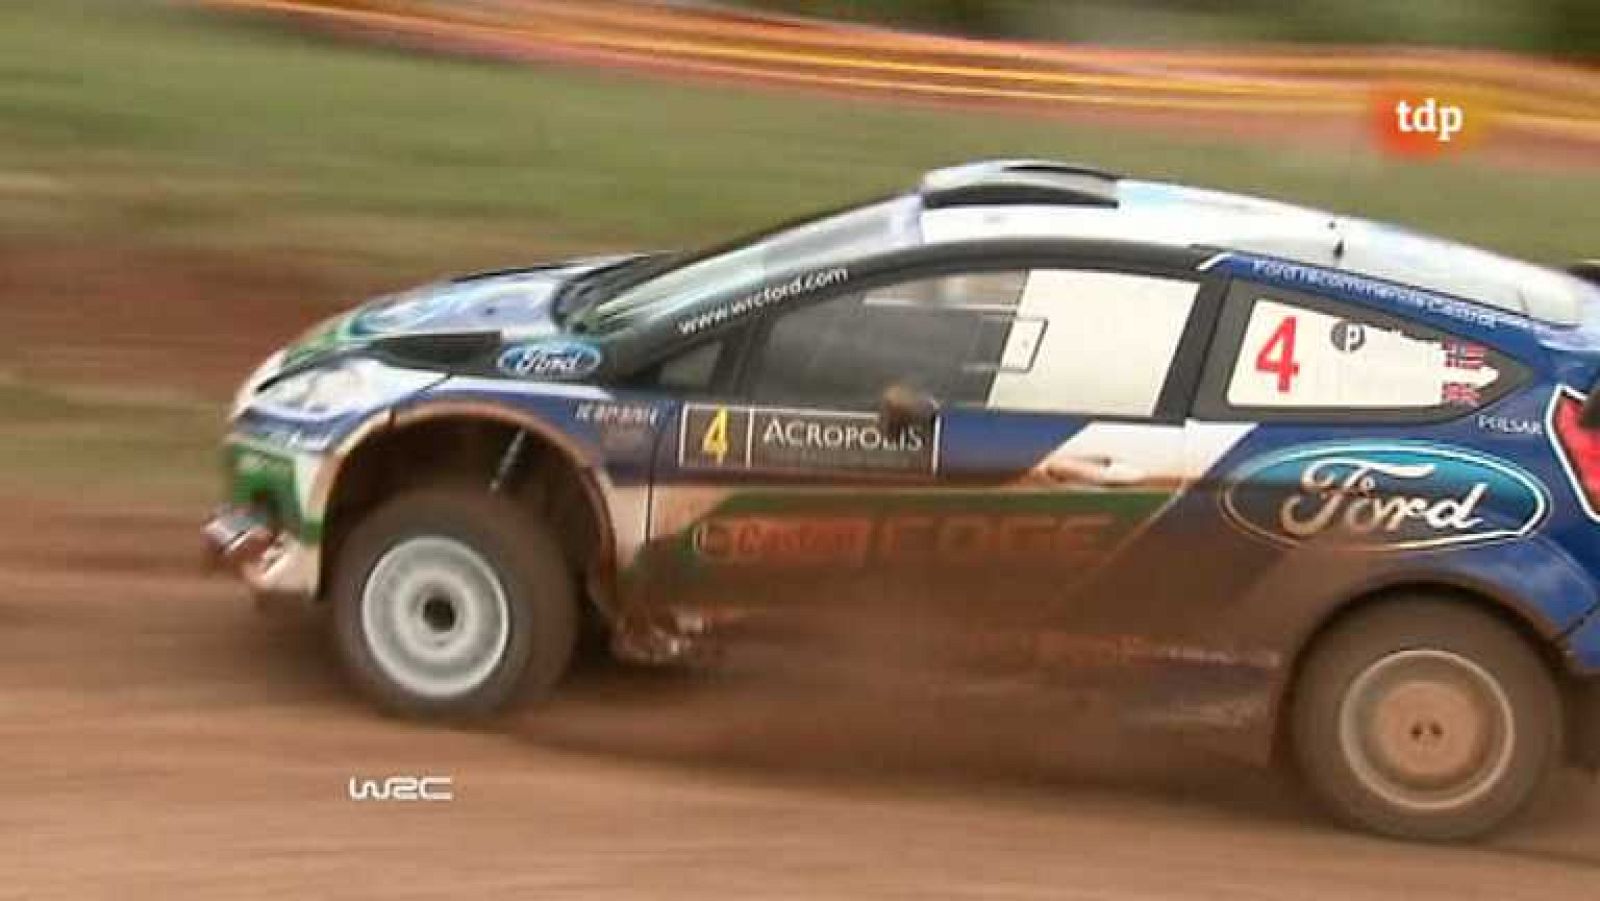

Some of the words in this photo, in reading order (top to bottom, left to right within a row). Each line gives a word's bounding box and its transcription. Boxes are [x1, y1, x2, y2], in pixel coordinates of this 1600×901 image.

[678, 267, 849, 335] www.wrcford.com
[516, 346, 583, 376] Ford
[1256, 316, 1299, 393] 4
[701, 406, 729, 467] 4
[1279, 457, 1488, 536] Ford
